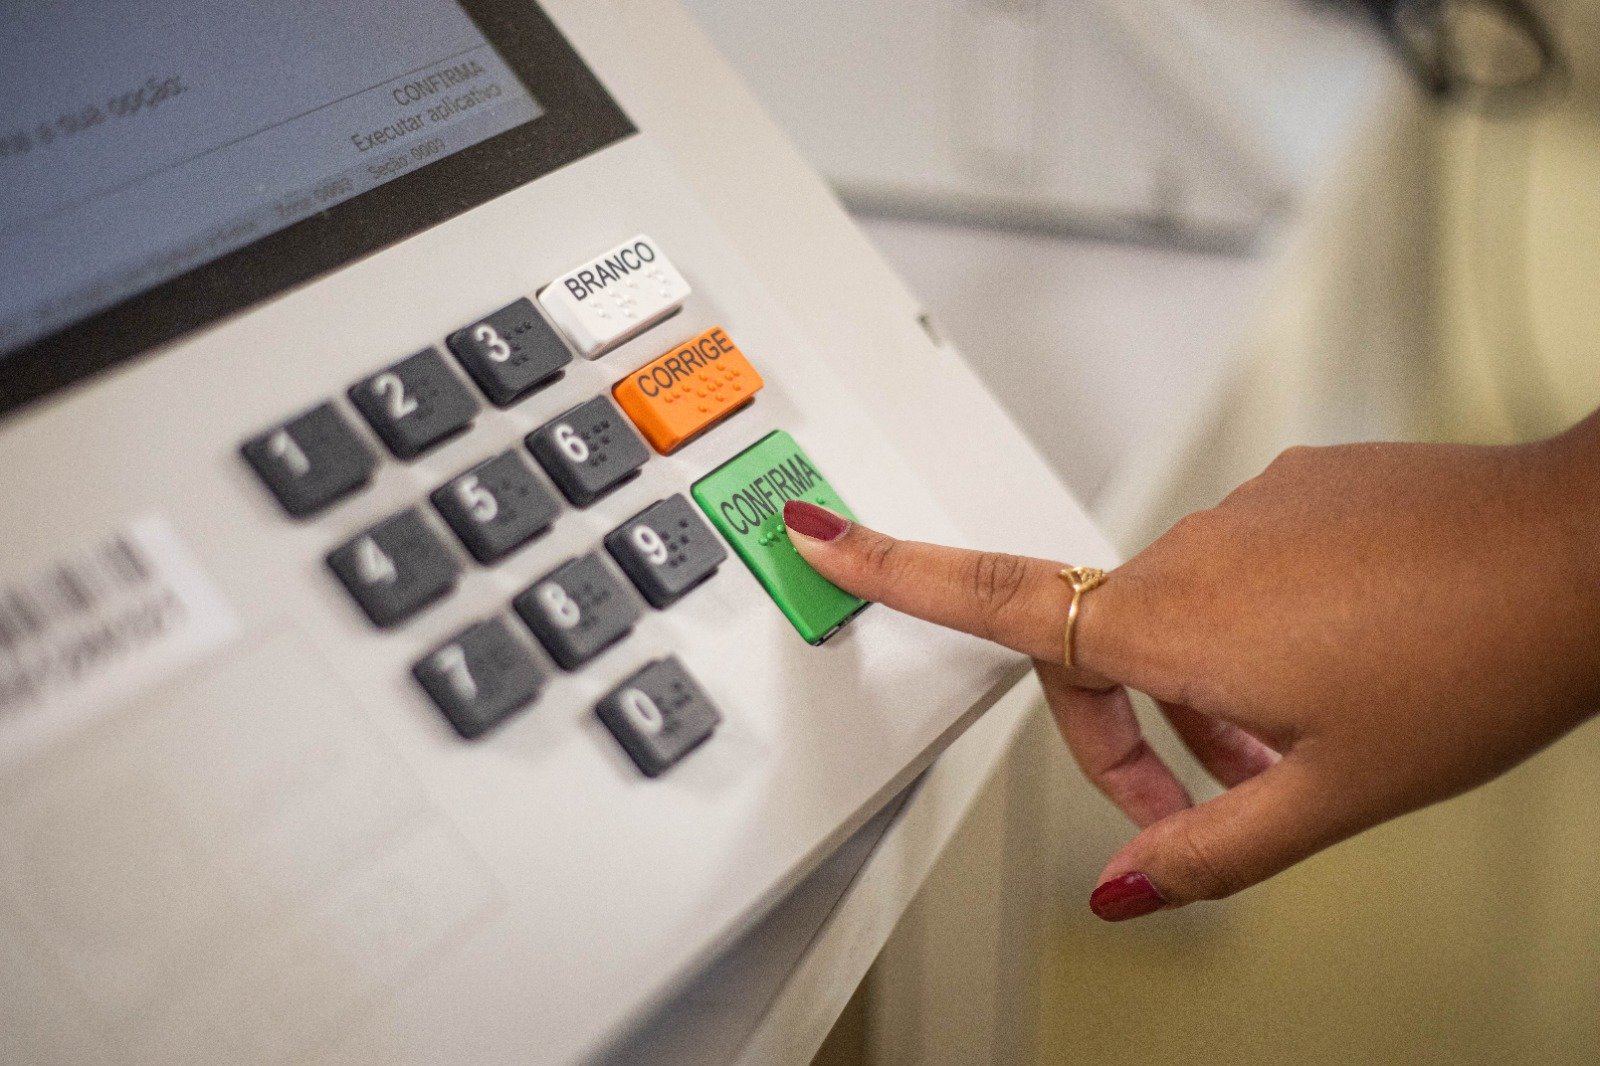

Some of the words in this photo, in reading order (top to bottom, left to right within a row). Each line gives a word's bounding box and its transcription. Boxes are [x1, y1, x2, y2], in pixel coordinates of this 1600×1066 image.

[392, 60, 485, 107] CONFIRMA
[350, 114, 425, 152] Executar
[427, 83, 502, 125] aplicativo
[564, 241, 656, 301] BRANCO
[473, 323, 512, 363] 3
[637, 329, 734, 398] CORRIGE
[371, 373, 418, 420] 2
[268, 429, 311, 475] 1
[553, 422, 590, 463] 6
[458, 473, 499, 523] 5
[720, 453, 823, 536] CONFIRMA
[354, 536, 398, 585] 4
[631, 523, 669, 566] 9
[538, 581, 582, 629] 8
[436, 643, 478, 699] 7
[619, 687, 665, 734] 0
